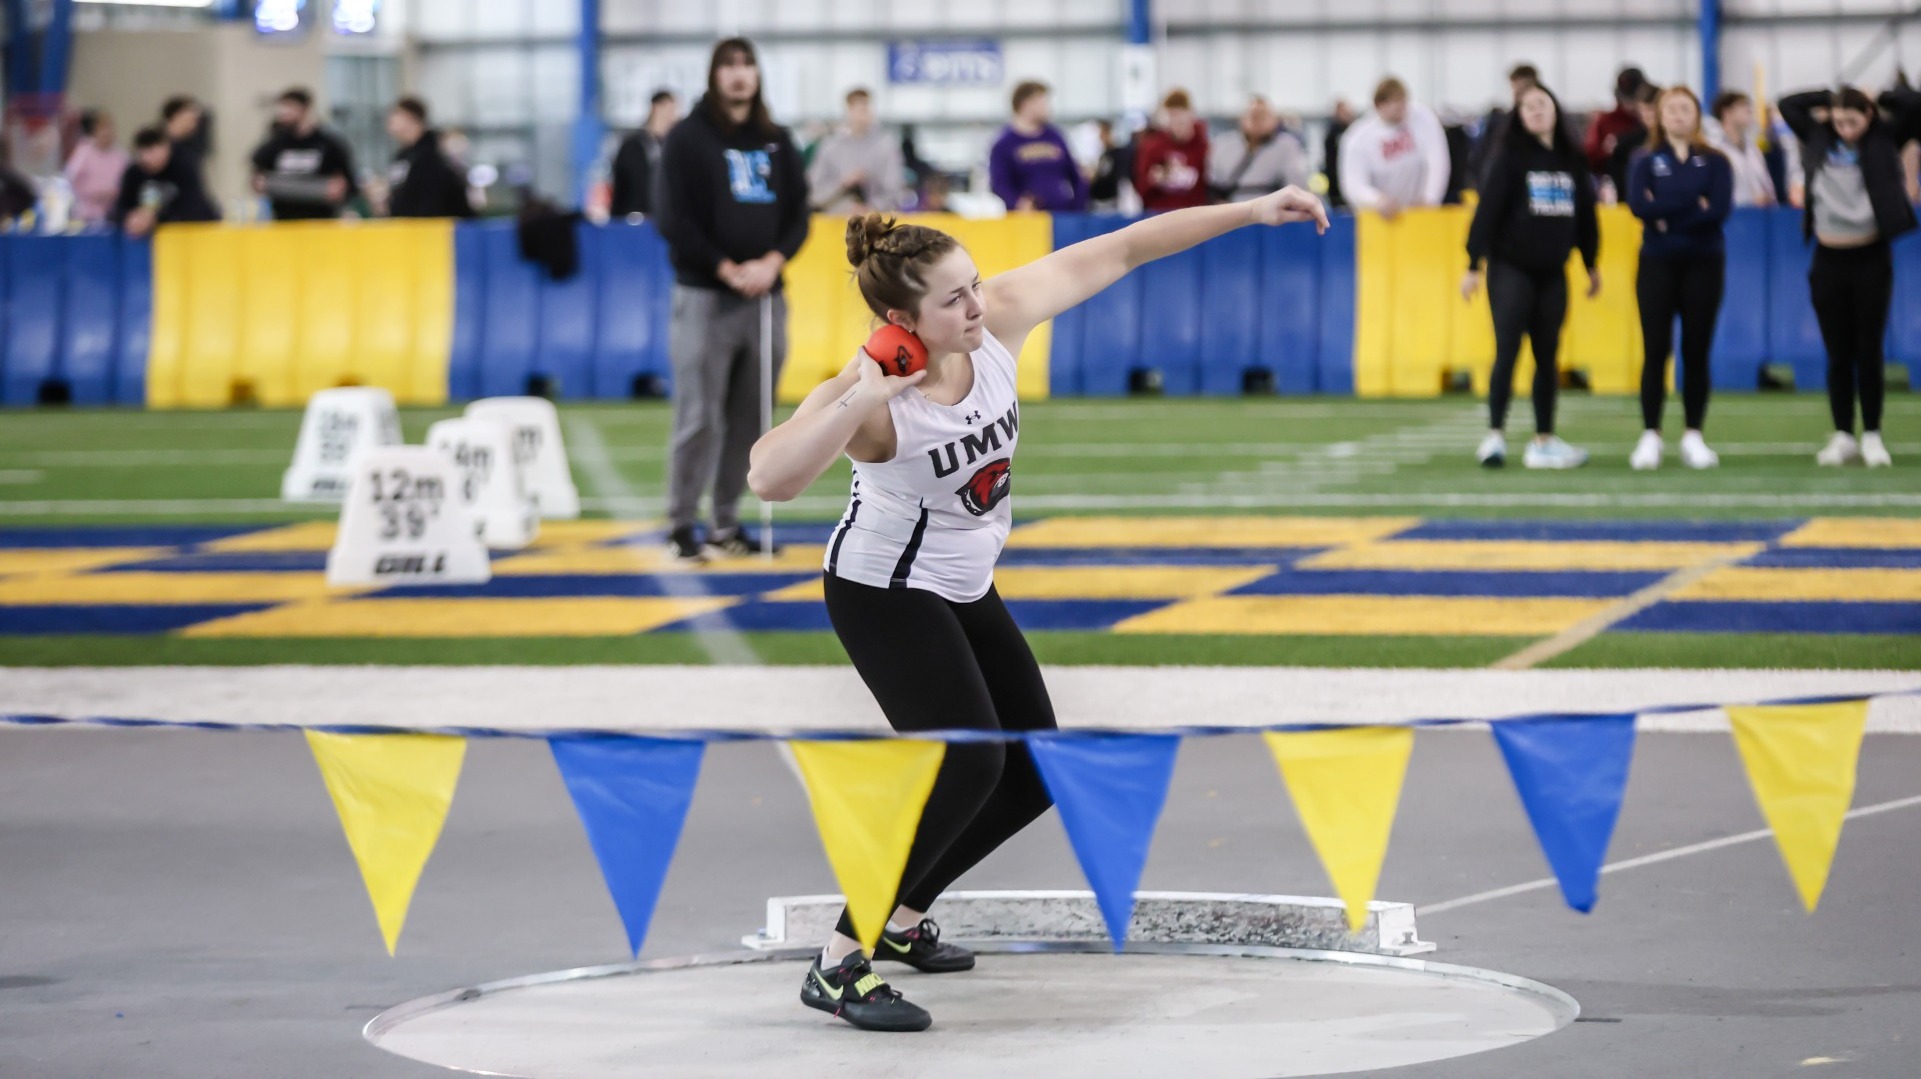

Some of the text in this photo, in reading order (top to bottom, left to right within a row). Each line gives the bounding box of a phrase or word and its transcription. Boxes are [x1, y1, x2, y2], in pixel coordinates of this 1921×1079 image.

[928, 401, 1018, 479] UMW
[370, 469, 444, 502] 12m
[379, 500, 440, 540] 39'
